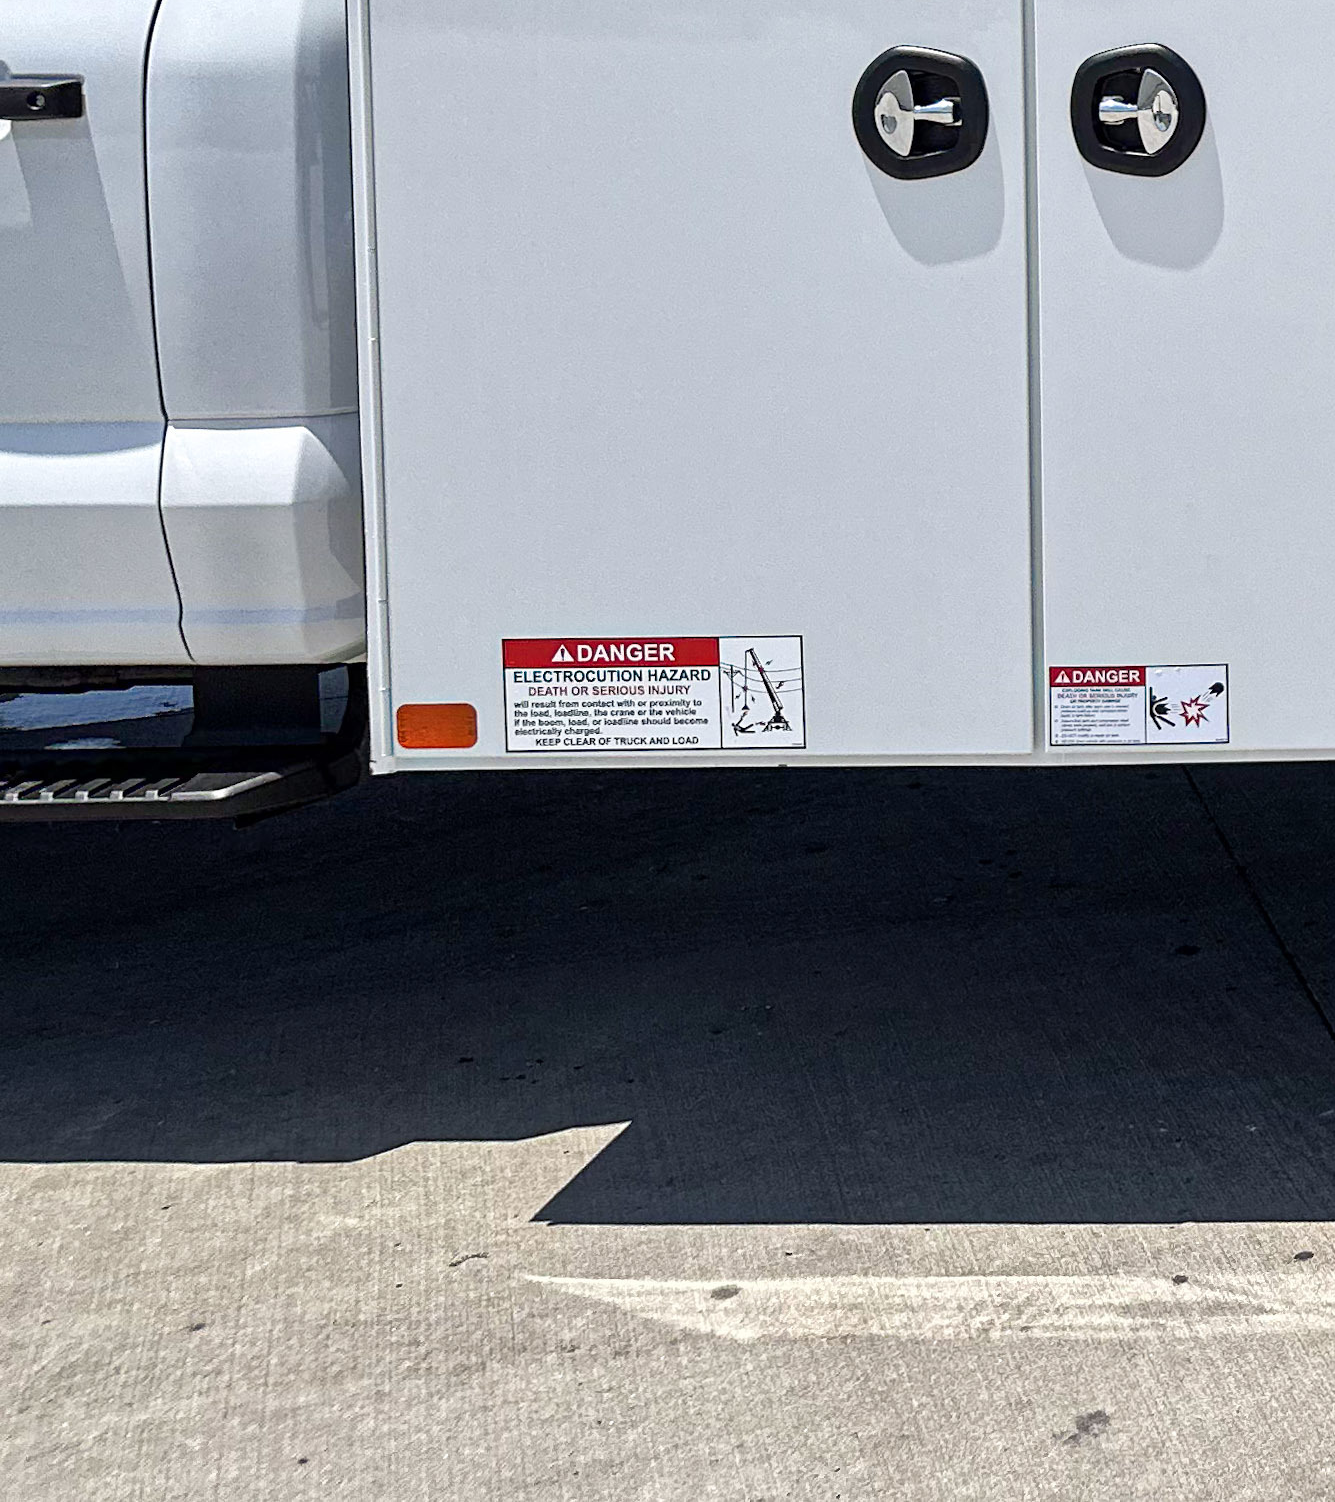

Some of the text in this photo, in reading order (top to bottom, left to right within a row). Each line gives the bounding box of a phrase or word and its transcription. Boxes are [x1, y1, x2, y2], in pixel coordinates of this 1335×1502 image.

[577, 643, 675, 663] DANGER
[513, 669, 711, 683] ELECTROCUTION HAZARD
[1072, 670, 1141, 683] DANGER
[528, 685, 691, 696] DEATH OR SERIOUS INJURY
[514, 700, 529, 708] will
[531, 700, 557, 708] result
[558, 700, 580, 708] from
[581, 700, 615, 708] contact
[616, 699, 636, 707] with
[649, 699, 692, 709] proximity
[693, 699, 702, 707] to
[514, 709, 528, 717] the
[594, 708, 608, 716] the
[649, 708, 663, 716] the
[665, 708, 697, 716] vehicle
[522, 718, 536, 726] the
[603, 717, 639, 726] loadline
[641, 717, 672, 725] should
[674, 717, 709, 725] become
[514, 727, 603, 737] electrically charged.
[535, 736, 699, 746] KEEP CLEAR OF TRUCK AND LOAD
